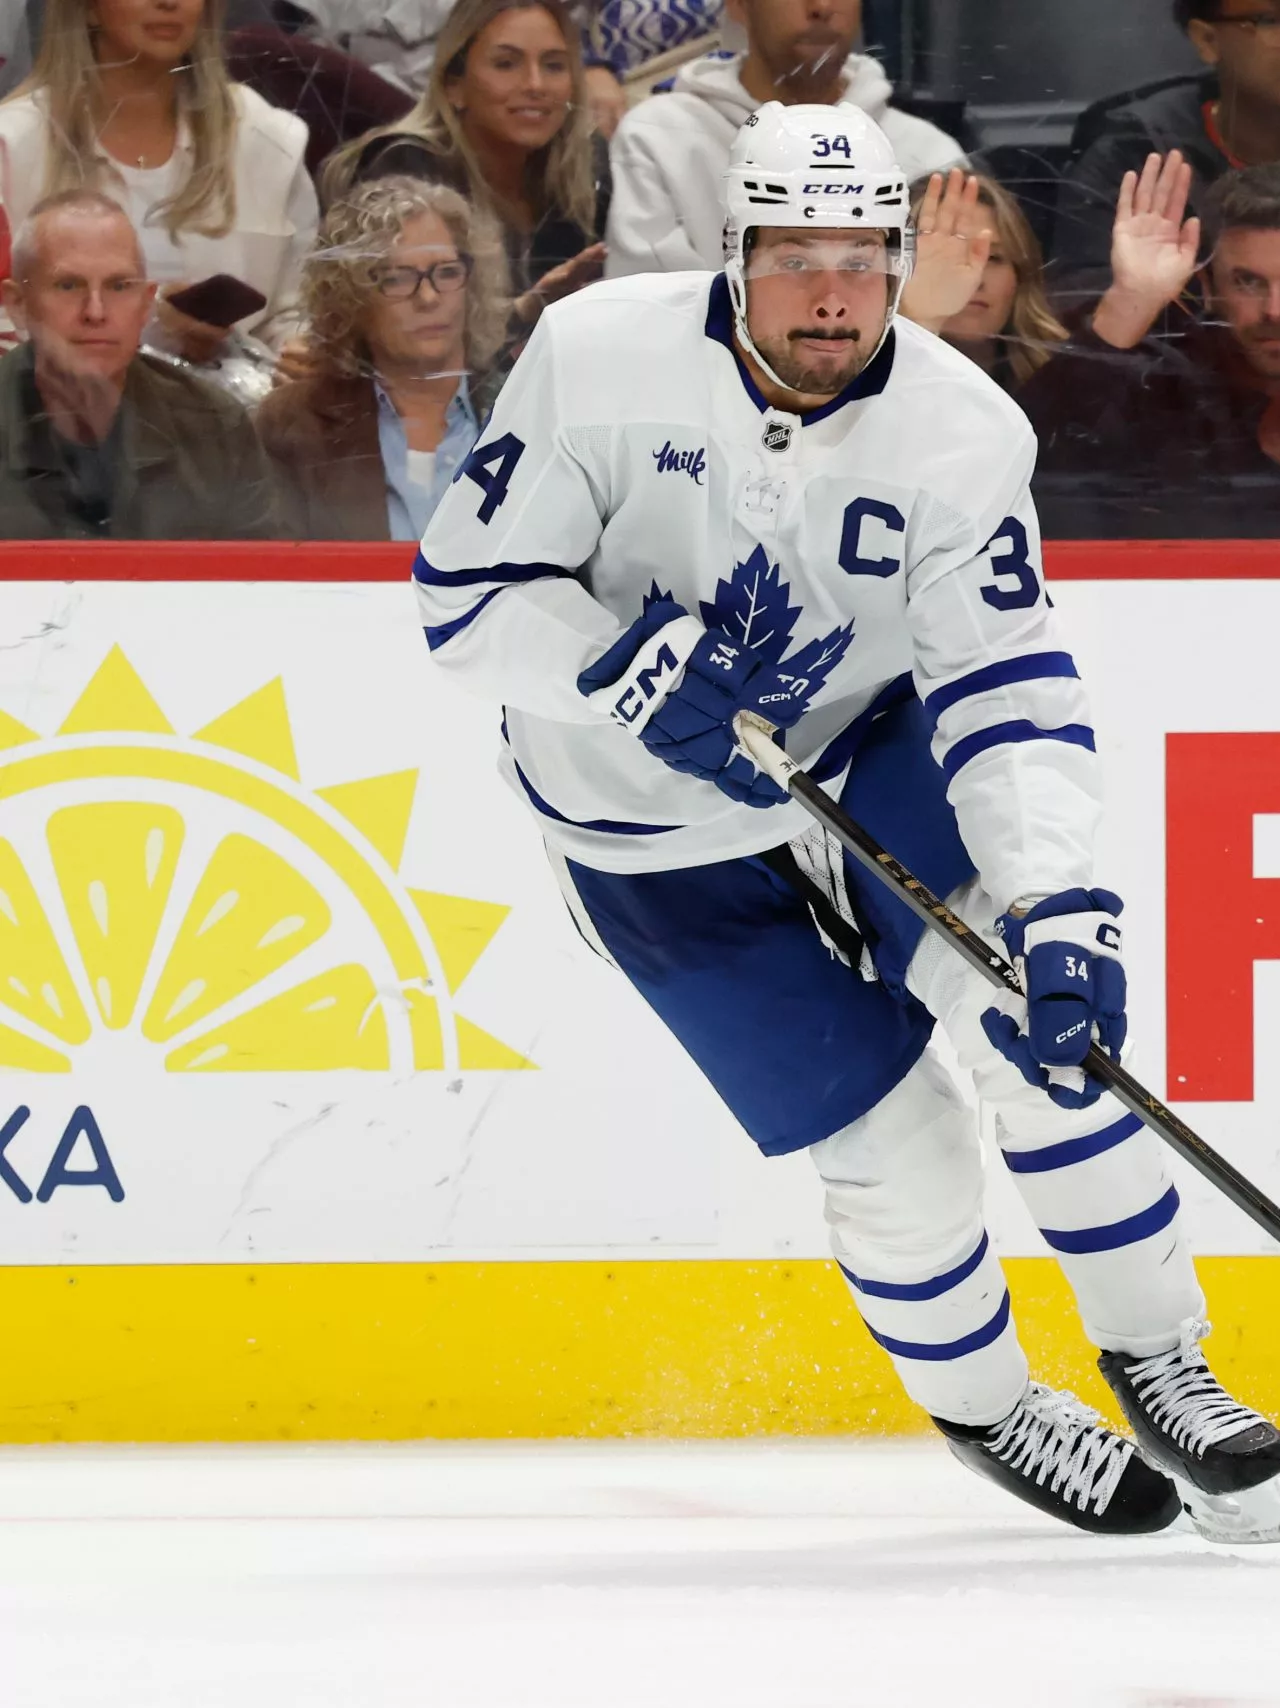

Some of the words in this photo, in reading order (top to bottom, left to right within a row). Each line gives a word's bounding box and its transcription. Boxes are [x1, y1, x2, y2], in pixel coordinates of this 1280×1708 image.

[811, 134, 851, 158] 34
[803, 184, 864, 195] CCM
[767, 430, 788, 445] NHL
[453, 407, 526, 526] 4
[652, 441, 706, 486] Milk
[838, 496, 906, 579] C
[975, 515, 1055, 612] 3
[709, 643, 740, 671] 34
[610, 642, 679, 730] CM
[758, 693, 791, 704] CCM
[1096, 922, 1121, 951] C
[1065, 956, 1089, 982] 34
[1055, 1019, 1086, 1045] CCM
